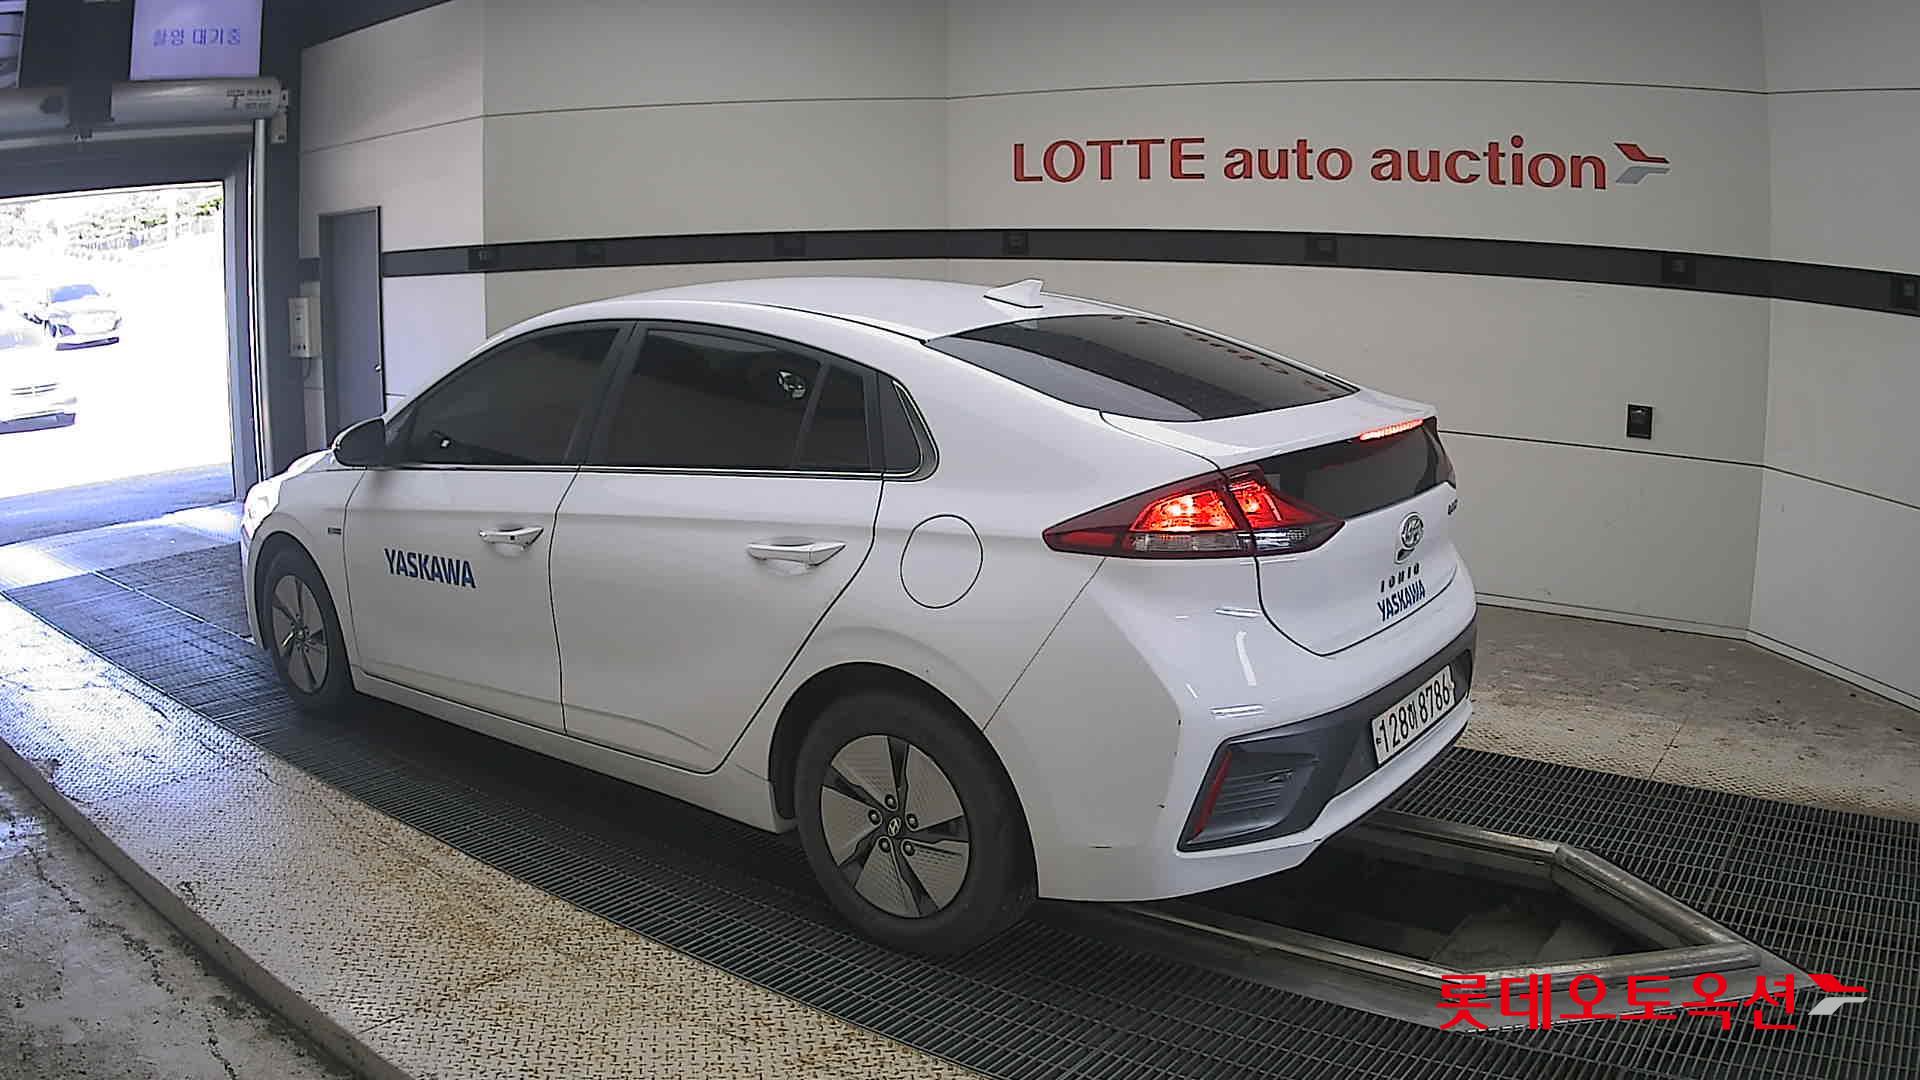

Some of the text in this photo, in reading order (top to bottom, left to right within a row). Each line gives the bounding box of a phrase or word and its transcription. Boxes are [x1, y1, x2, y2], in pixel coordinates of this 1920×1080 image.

[1012, 135, 1608, 189] LOTTE auto auction
[384, 548, 476, 588] YASKAWA
[1377, 579, 1426, 622] YASKAWA
